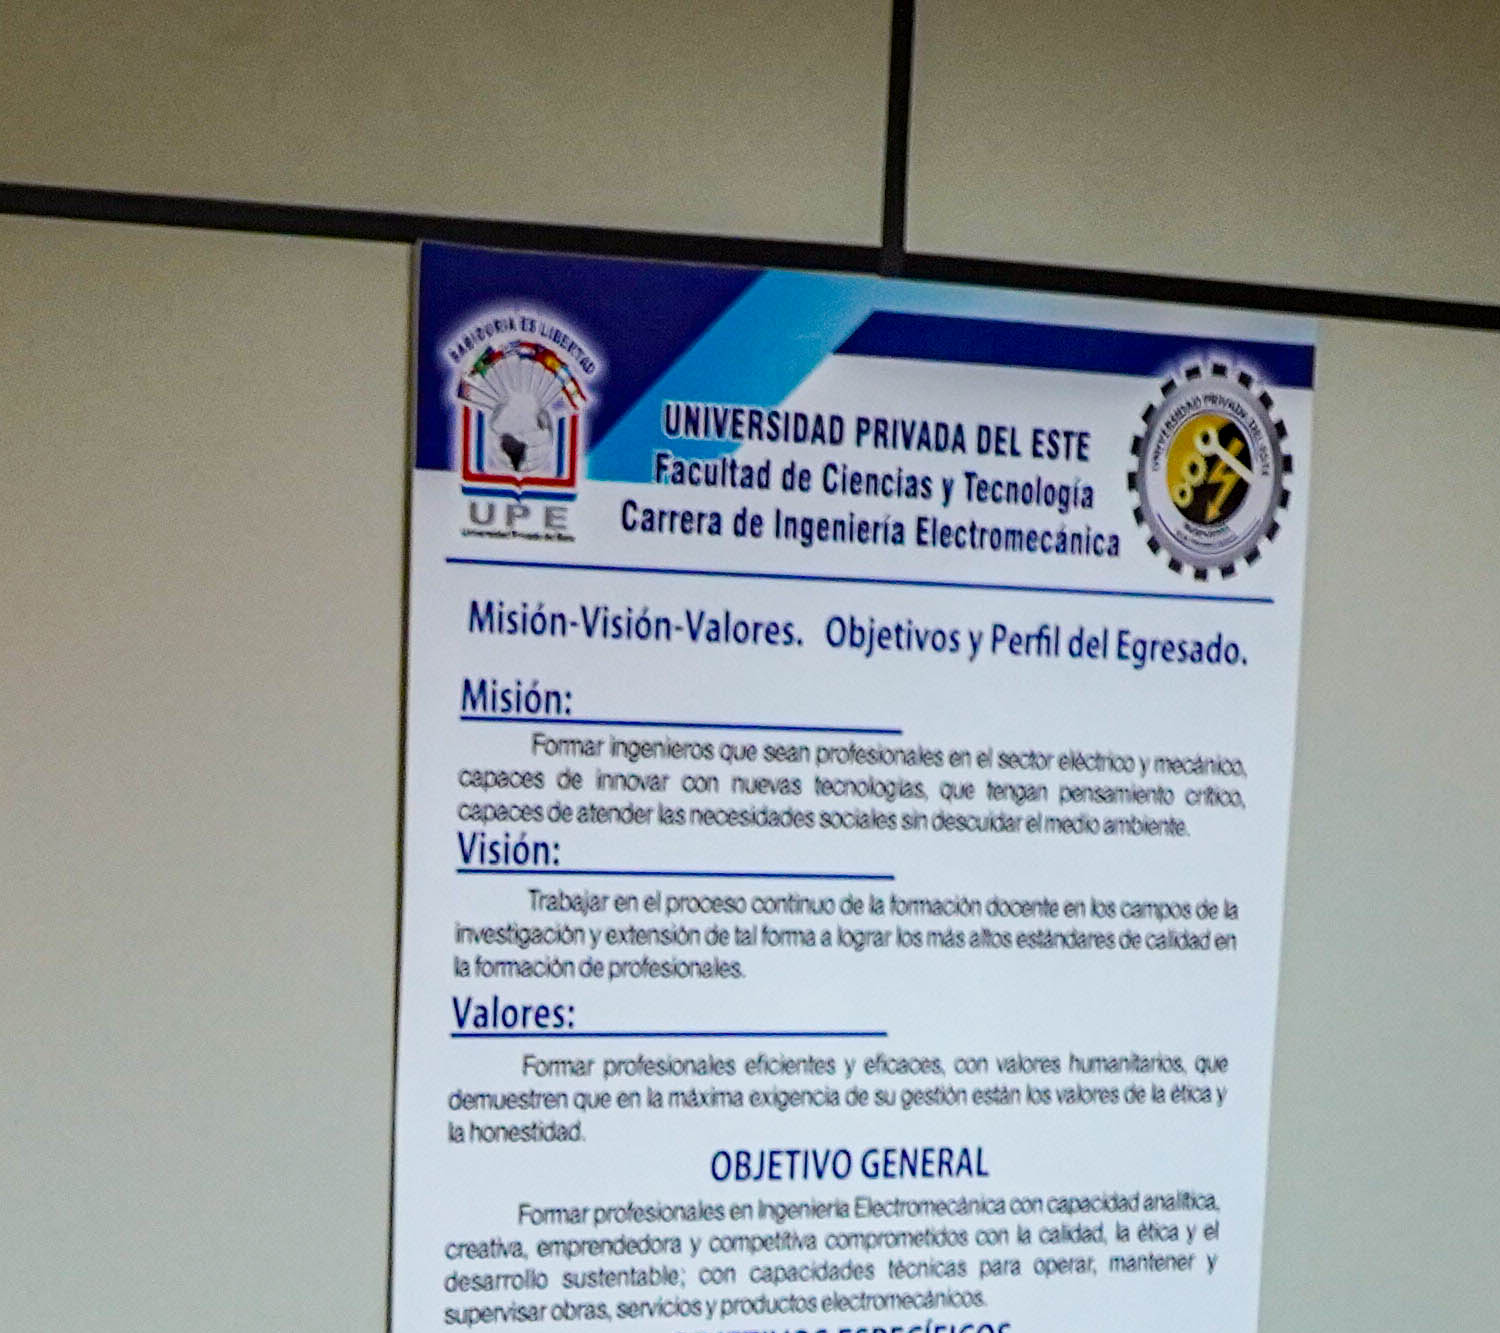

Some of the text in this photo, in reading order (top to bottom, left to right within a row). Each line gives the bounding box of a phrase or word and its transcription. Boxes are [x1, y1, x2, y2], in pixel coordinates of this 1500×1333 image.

[520, 316, 537, 332] ES
[540, 324, 596, 375] LIBERTAD
[666, 404, 1090, 462] UNIVERSIDAD PRIVADA DEL ESTE
[656, 453, 1093, 515] Facultad de Ciencias y Tecnología
[468, 500, 569, 530] UPE
[622, 499, 1119, 557] Carrera de Ingeniería Electromecánica
[469, 600, 1247, 670] Misión-Visión-Valores. Objetivos y Perfil del Egresado.
[462, 678, 571, 715] Misión:
[532, 732, 1247, 778] Formar ingenieros que sean profesionales en el sector eléctrico y mecánico,
[458, 768, 545, 793] capaces
[556, 768, 583, 790] de
[596, 769, 670, 793] innovar
[681, 775, 719, 794] con
[731, 776, 802, 795] nuevas
[814, 776, 928, 803] tecnologías,
[939, 782, 975, 802] que
[986, 781, 1048, 807] tengan
[1059, 784, 1174, 806] pensamiento
[458, 831, 559, 866] Visión:
[453, 994, 574, 1029] Valores:
[522, 1052, 1228, 1081] Formar profesionales eficientes y eficaces, con valores humanitarios, que
[712, 1147, 988, 1181] OBJETIVO GENERAL
